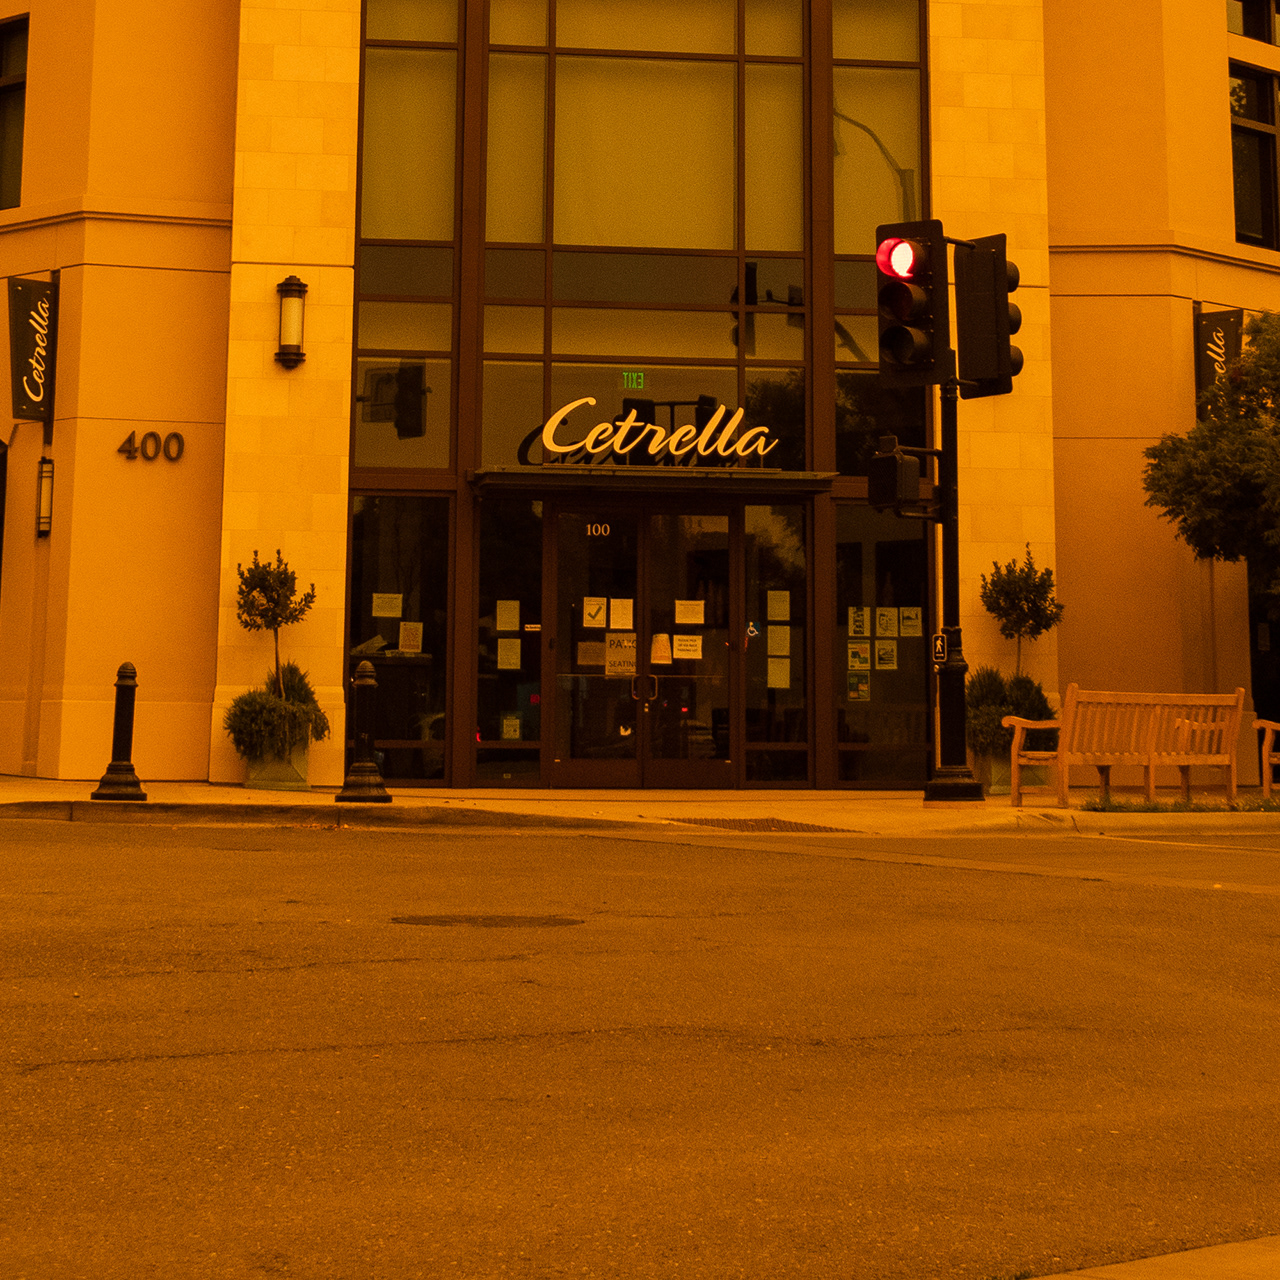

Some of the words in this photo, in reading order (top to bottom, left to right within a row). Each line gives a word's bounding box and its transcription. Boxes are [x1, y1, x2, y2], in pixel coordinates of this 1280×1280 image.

[22, 297, 51, 402] Cetrella
[542, 396, 779, 456] Cetrella
[117, 430, 185, 462] 400
[585, 523, 611, 537] 100
[608, 660, 637, 668] SEATIN
